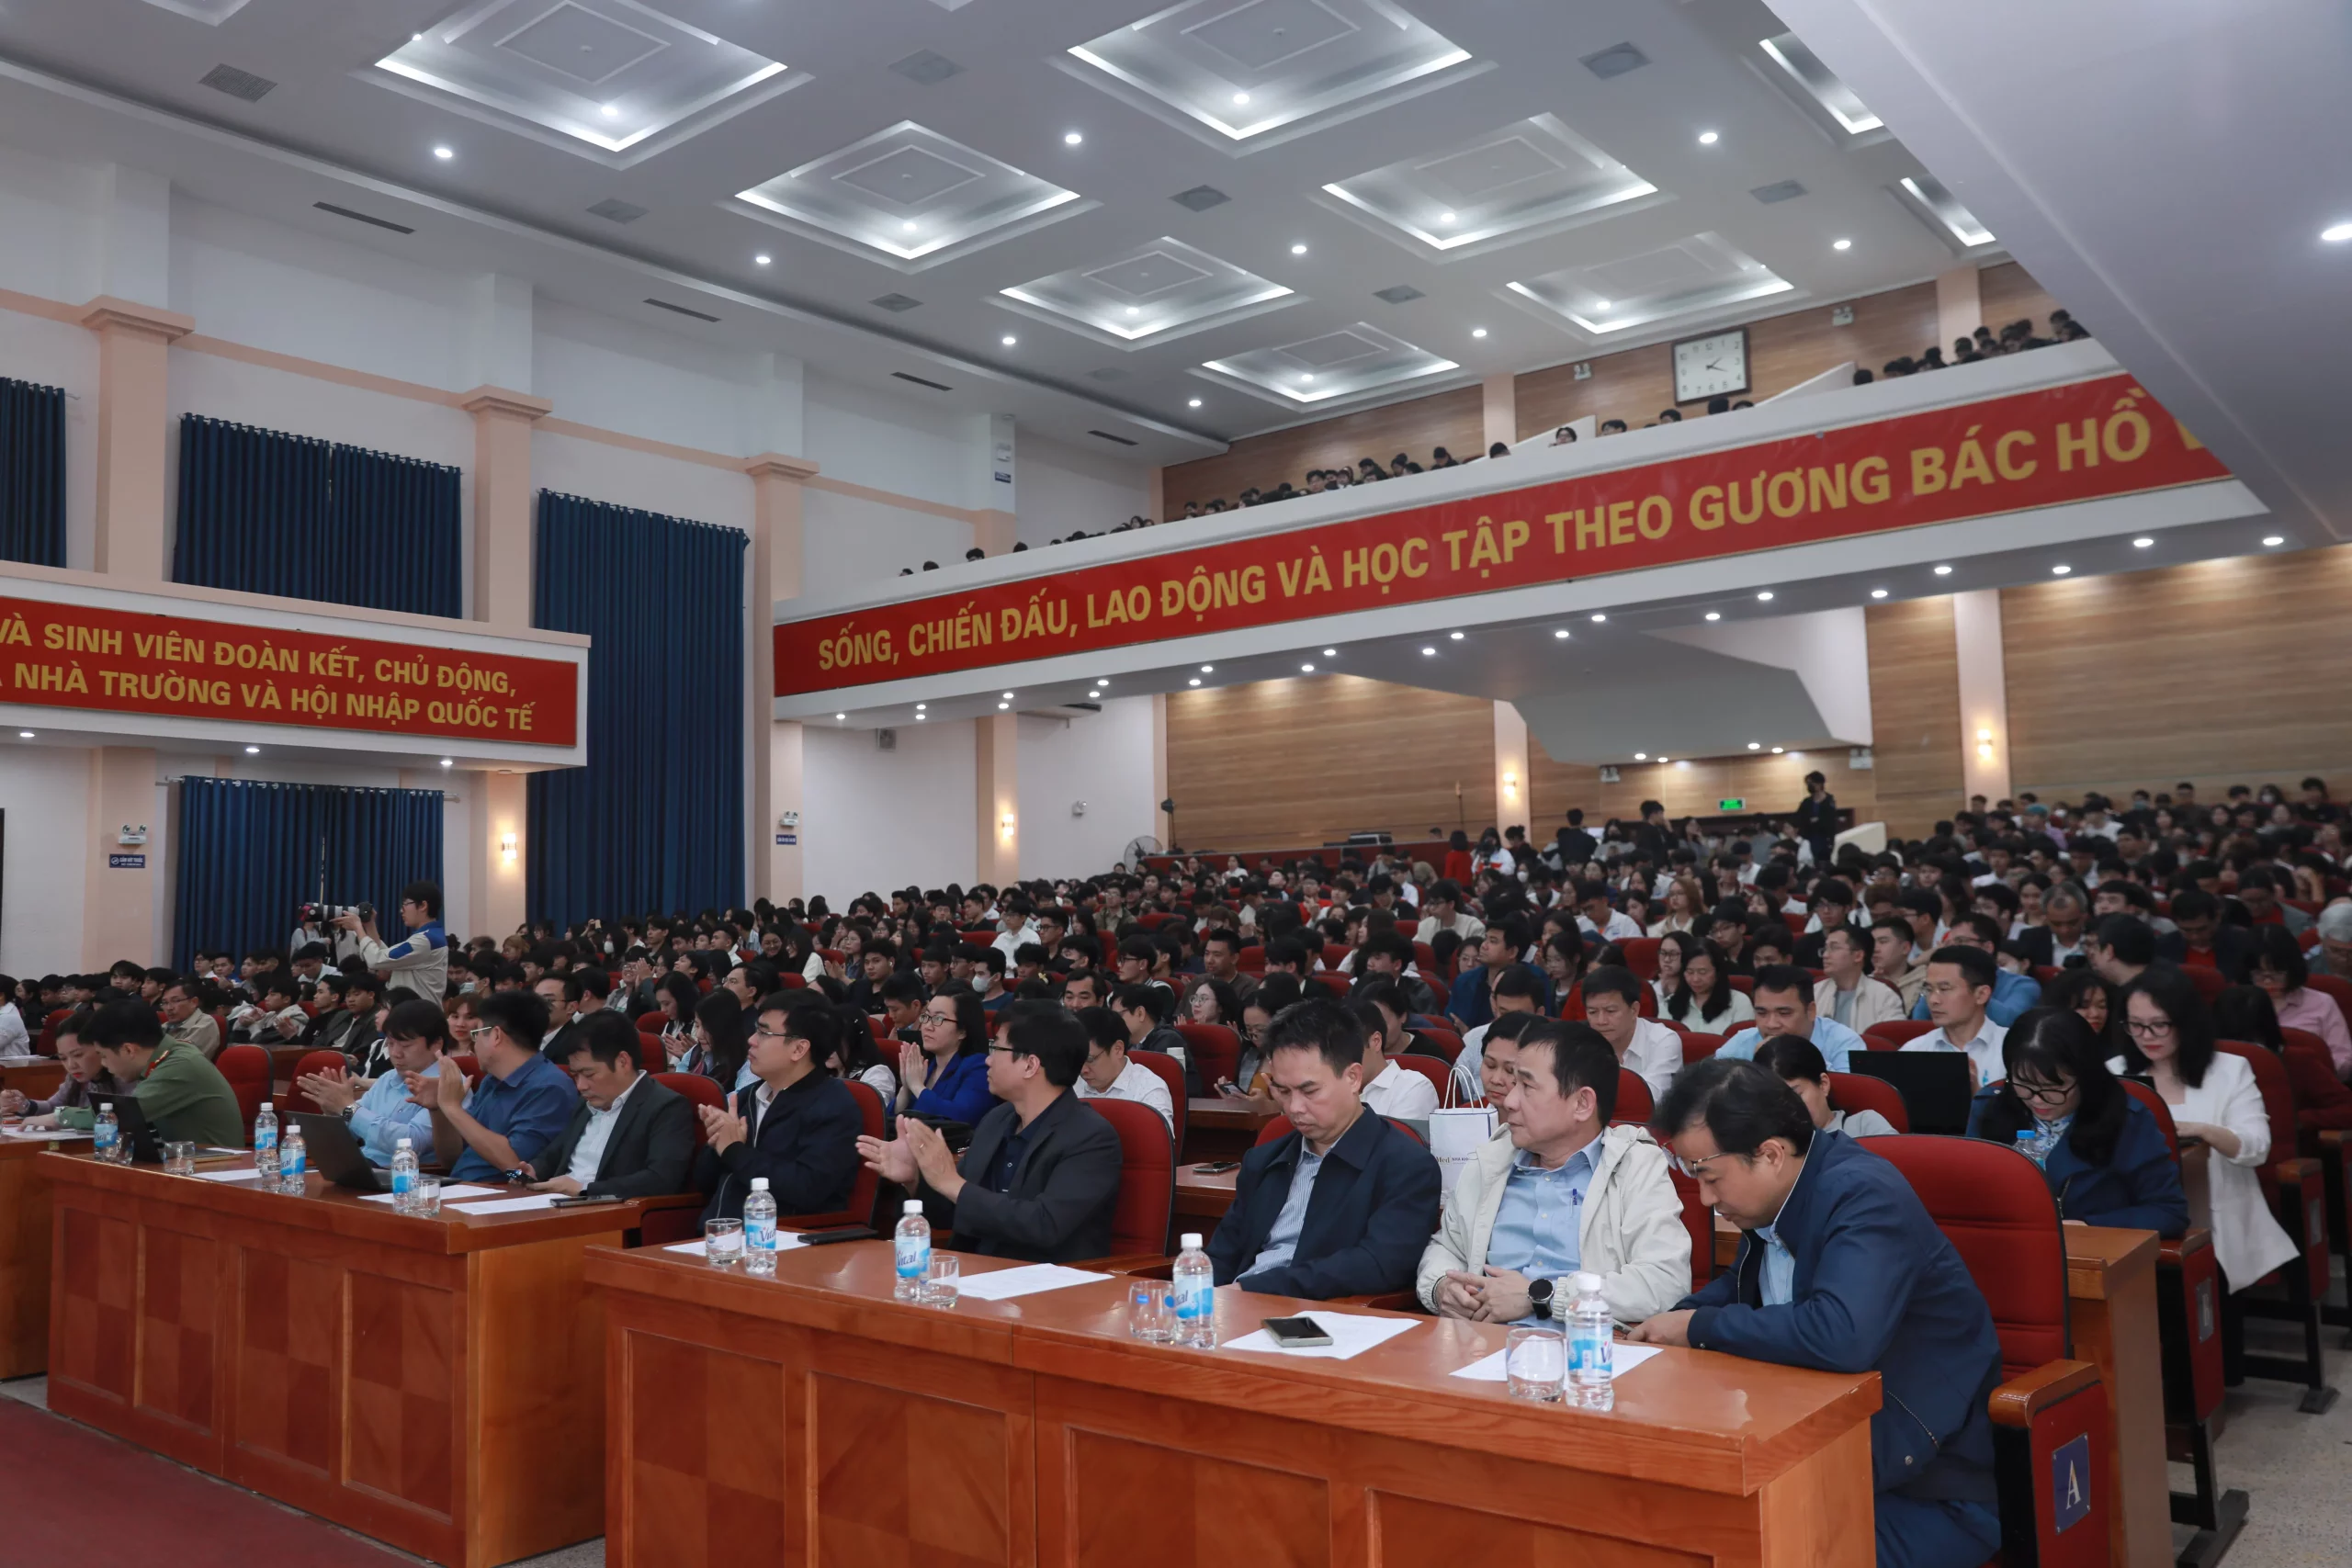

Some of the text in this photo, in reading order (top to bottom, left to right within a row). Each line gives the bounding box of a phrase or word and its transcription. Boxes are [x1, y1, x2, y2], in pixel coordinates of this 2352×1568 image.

[819, 622, 899, 670] SỐNG,
[909, 601, 992, 657] CHIẾN
[1000, 587, 1078, 642] ĐẤU,
[1087, 585, 1152, 628] LAO
[1160, 565, 1266, 622] ĐỘNG
[1276, 545, 1333, 597] VÀ
[1343, 537, 1430, 594] HỌC
[1442, 515, 1530, 578] TẬP
[1544, 495, 1673, 554] THEO
[1689, 457, 1891, 530] GƯƠNG
[1911, 425, 2037, 495] BÁC
[2056, 387, 2151, 471] HỒ
[15, 660, 536, 731] NHÀ TRƯỜNG VÀ HỘI NHẬP QUỐC TẾ
[43, 623, 122, 655] SINH
[132, 630, 205, 663] VIÊN
[213, 639, 299, 673] ĐOÀN
[309, 645, 365, 683] KẾT,
[375, 653, 429, 686] CHỦ
[436, 661, 515, 697] ĐỘNG,
[2066, 1460, 2081, 1510] A
